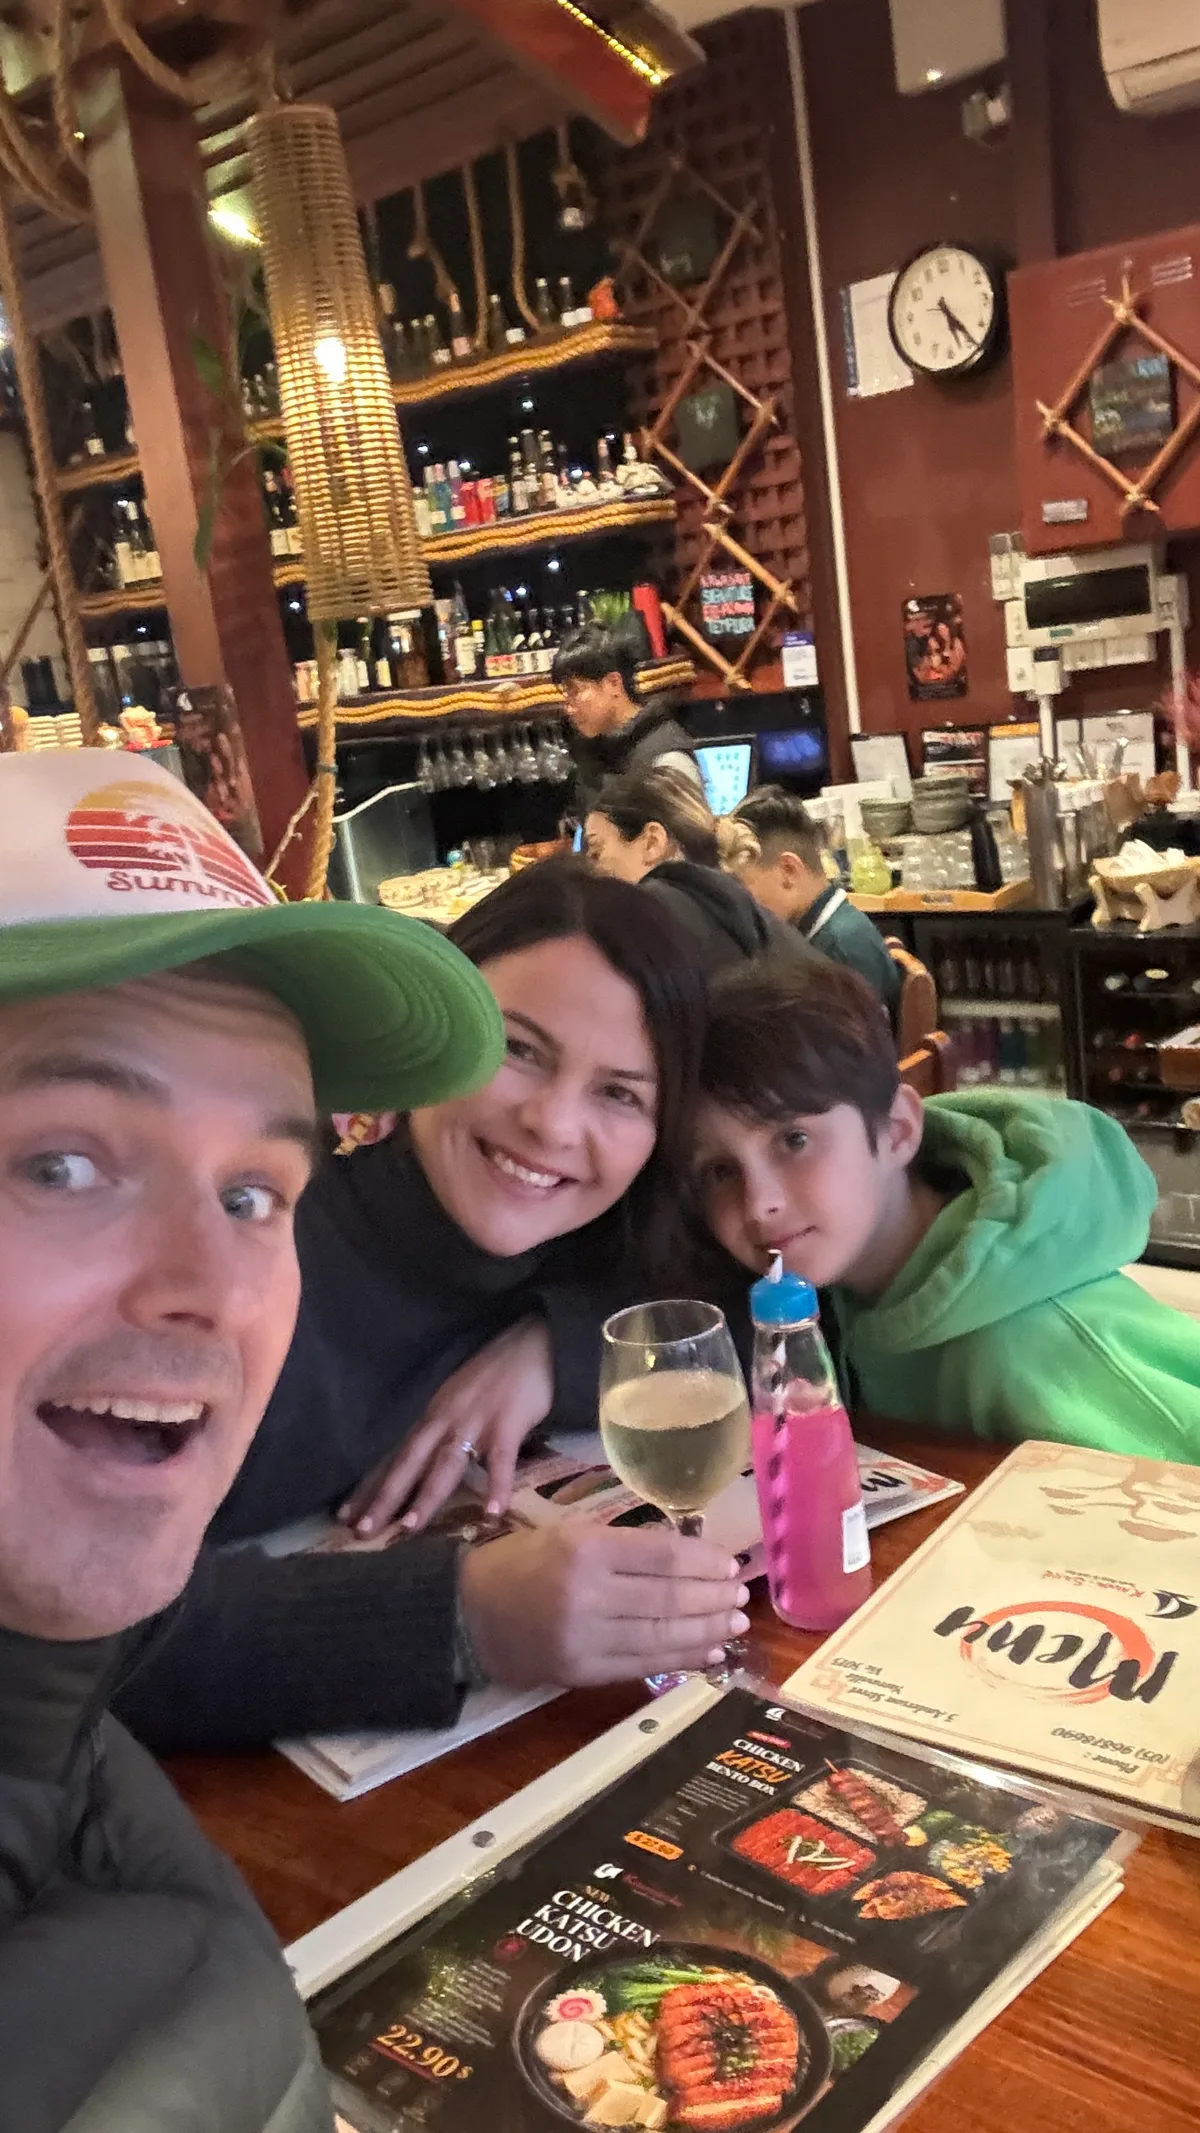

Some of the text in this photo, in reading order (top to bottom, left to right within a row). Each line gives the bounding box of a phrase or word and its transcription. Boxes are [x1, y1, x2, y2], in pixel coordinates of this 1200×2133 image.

[106, 869, 252, 907] Summ
[932, 1604, 1180, 1705] Menu
[715, 1749, 793, 1784] KATSU
[732, 1738, 806, 1773] CHICKEN
[705, 1760, 779, 1796] BENTO BOX
[533, 1903, 619, 1951] KATSU
[551, 1889, 662, 1949] CHICKEN
[515, 1918, 592, 1964] UDON
